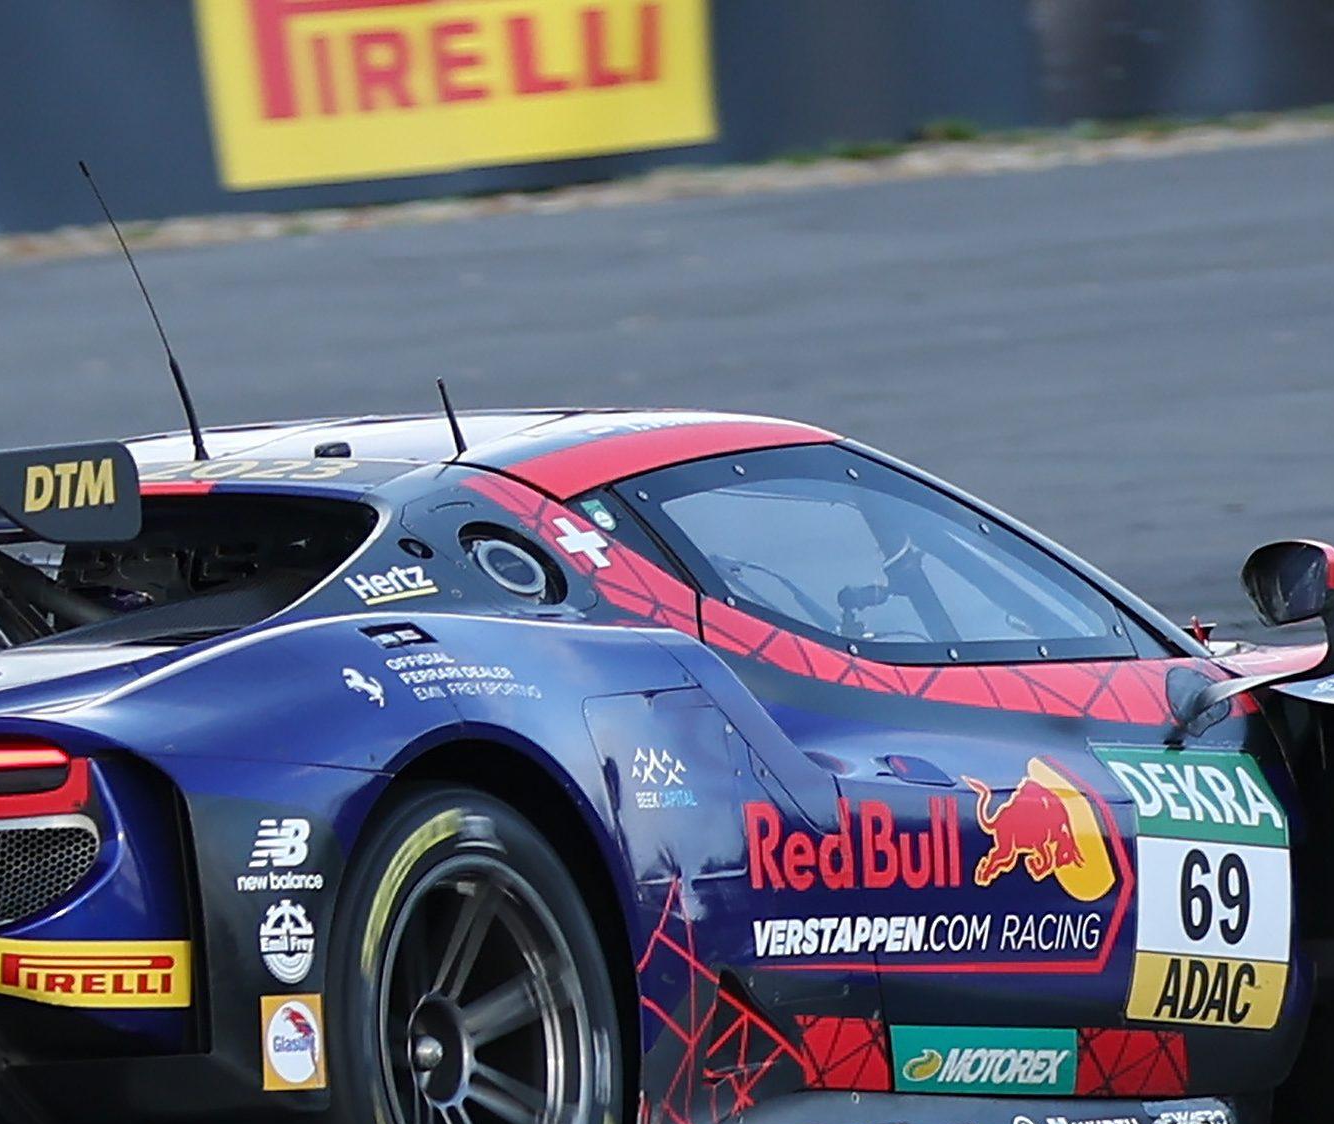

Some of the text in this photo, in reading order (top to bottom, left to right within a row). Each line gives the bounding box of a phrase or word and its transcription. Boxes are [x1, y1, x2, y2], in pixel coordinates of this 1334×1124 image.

[24, 458, 115, 513] DTM
[139, 459, 359, 480] 2023
[344, 566, 435, 600] Hertz
[1107, 761, 1284, 829] DEKRA
[742, 795, 962, 891] Red Bull
[237, 871, 324, 891] new balance
[1180, 848, 1251, 946] 69
[753, 912, 1102, 957] VERSTAPPEN.COM RACING
[1, 953, 175, 994] PIRELLI
[1153, 958, 1256, 1024] ADAC
[937, 1047, 1071, 1085] MOTOREX
